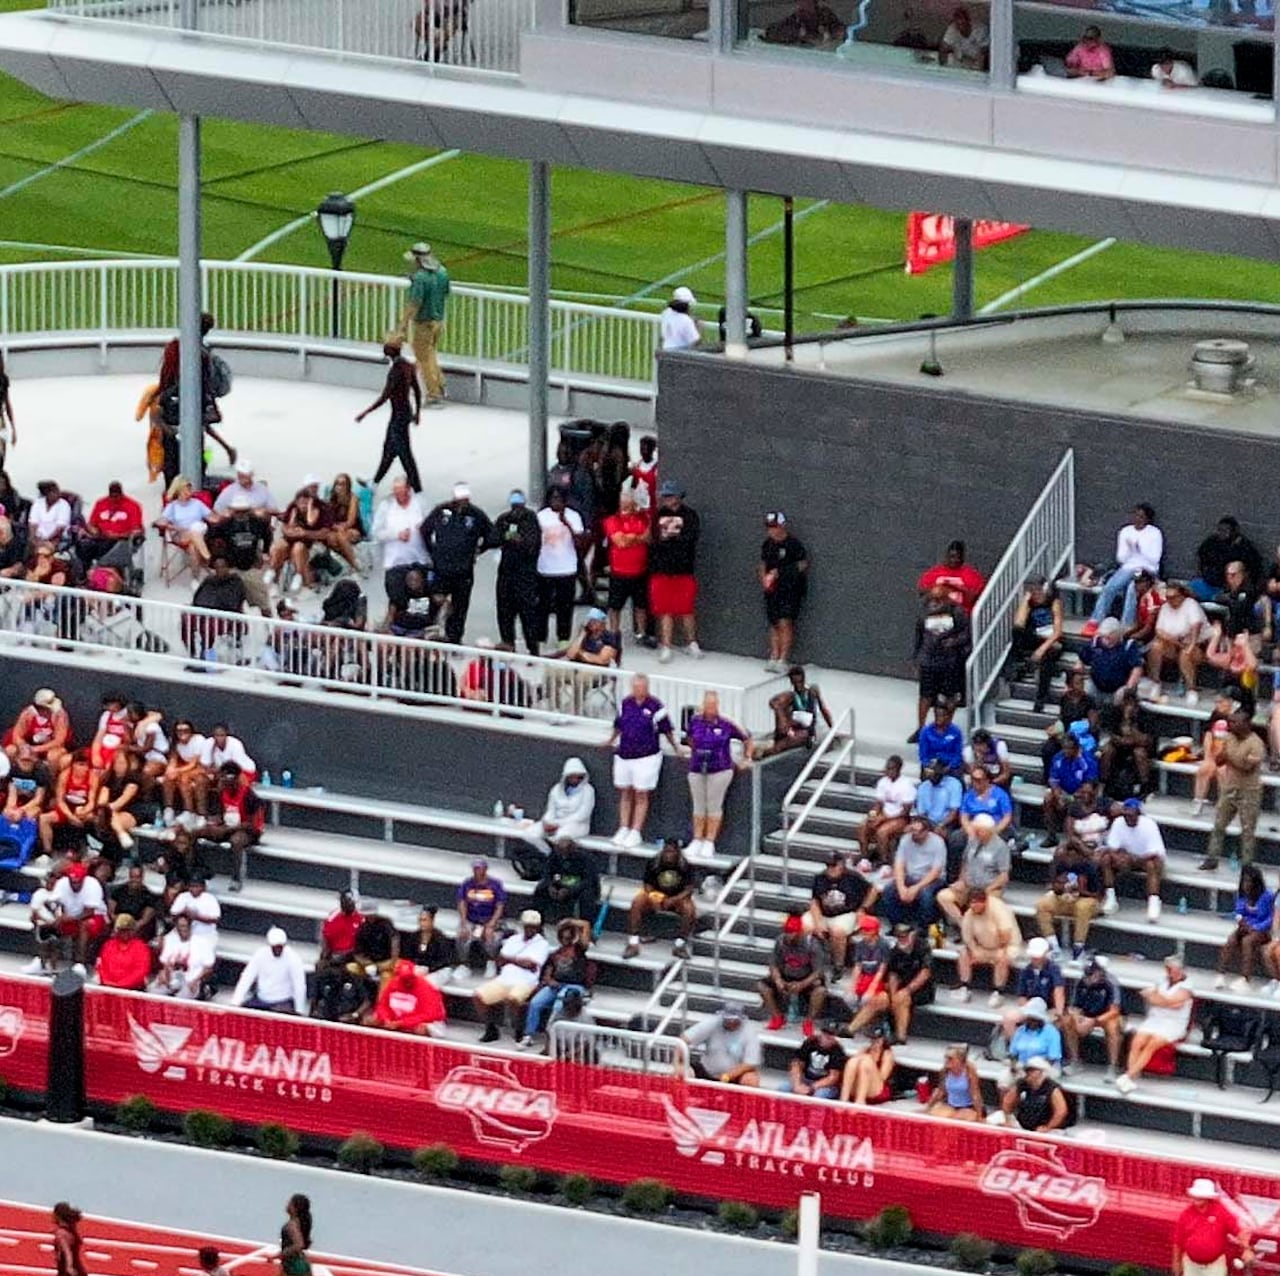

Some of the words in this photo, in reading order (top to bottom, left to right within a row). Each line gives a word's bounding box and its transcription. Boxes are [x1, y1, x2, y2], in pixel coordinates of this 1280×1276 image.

[196, 1034, 332, 1084] ATLANTA
[195, 1067, 263, 1092] TRACK
[277, 1081, 332, 1102] CLUB
[440, 1084, 554, 1118] GHSA
[736, 1119, 874, 1168] ATLANTA
[736, 1153, 805, 1175] TRACK
[818, 1166, 874, 1188] CLUB
[983, 1166, 1103, 1205] GHSA
